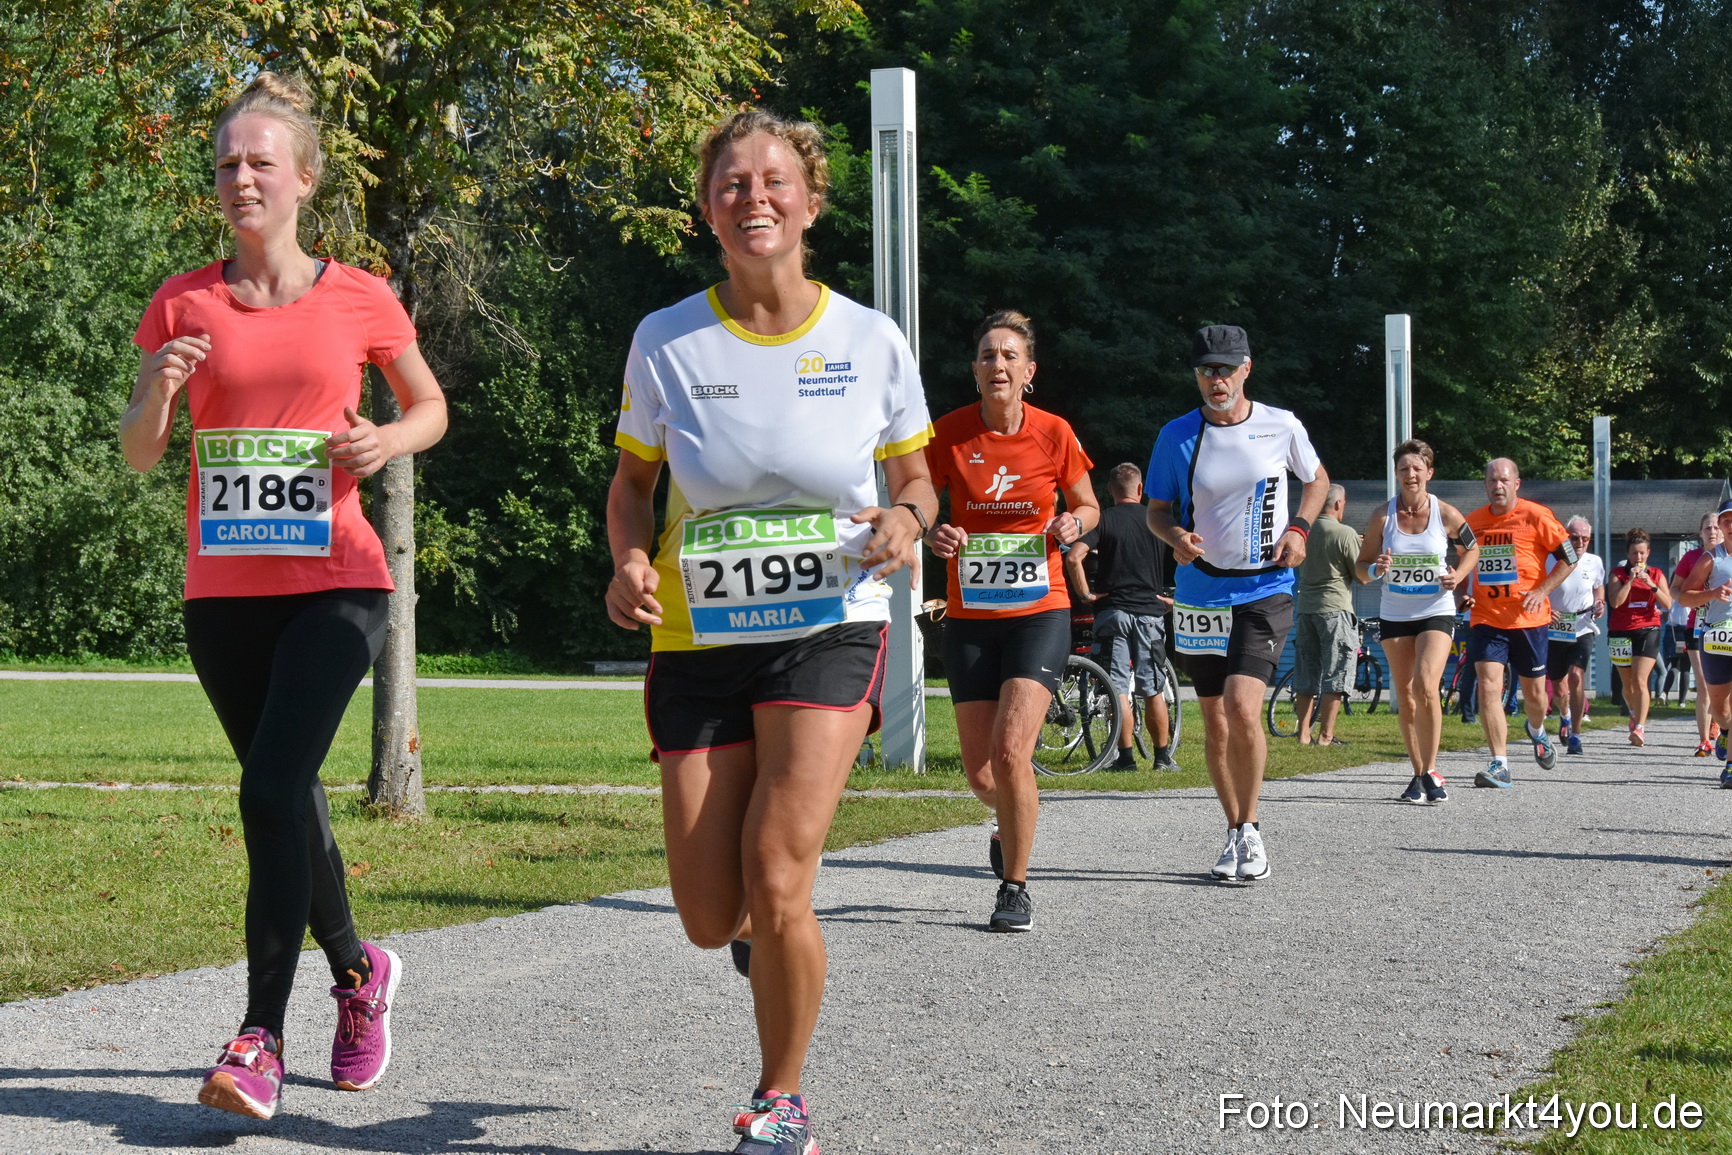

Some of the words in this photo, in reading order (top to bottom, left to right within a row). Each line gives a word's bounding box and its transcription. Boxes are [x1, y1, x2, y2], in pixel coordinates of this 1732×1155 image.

[798, 357, 823, 374] 20
[826, 363, 849, 372] JAHRE
[798, 374, 858, 386] Neumarkter
[691, 385, 739, 396] BOCK
[798, 386, 847, 397] Stadtlauf
[204, 435, 319, 464] BOCK
[212, 474, 315, 512] 2186
[966, 500, 1033, 511] funrunners
[1252, 496, 1262, 560] TECHNOLOGY
[1260, 477, 1280, 563] HUBER
[217, 524, 305, 541] CAROLIN
[693, 514, 825, 551] BOCK
[965, 537, 1039, 555] BOCK
[1392, 556, 1434, 565] BOCK
[1479, 559, 1512, 572] 2832
[699, 552, 823, 600] 2199
[969, 561, 1038, 584] 2738
[1392, 569, 1434, 583] 2760
[729, 607, 805, 628] MARIA
[1177, 611, 1224, 633] 2191
[1178, 636, 1226, 648] WOLFGANG
